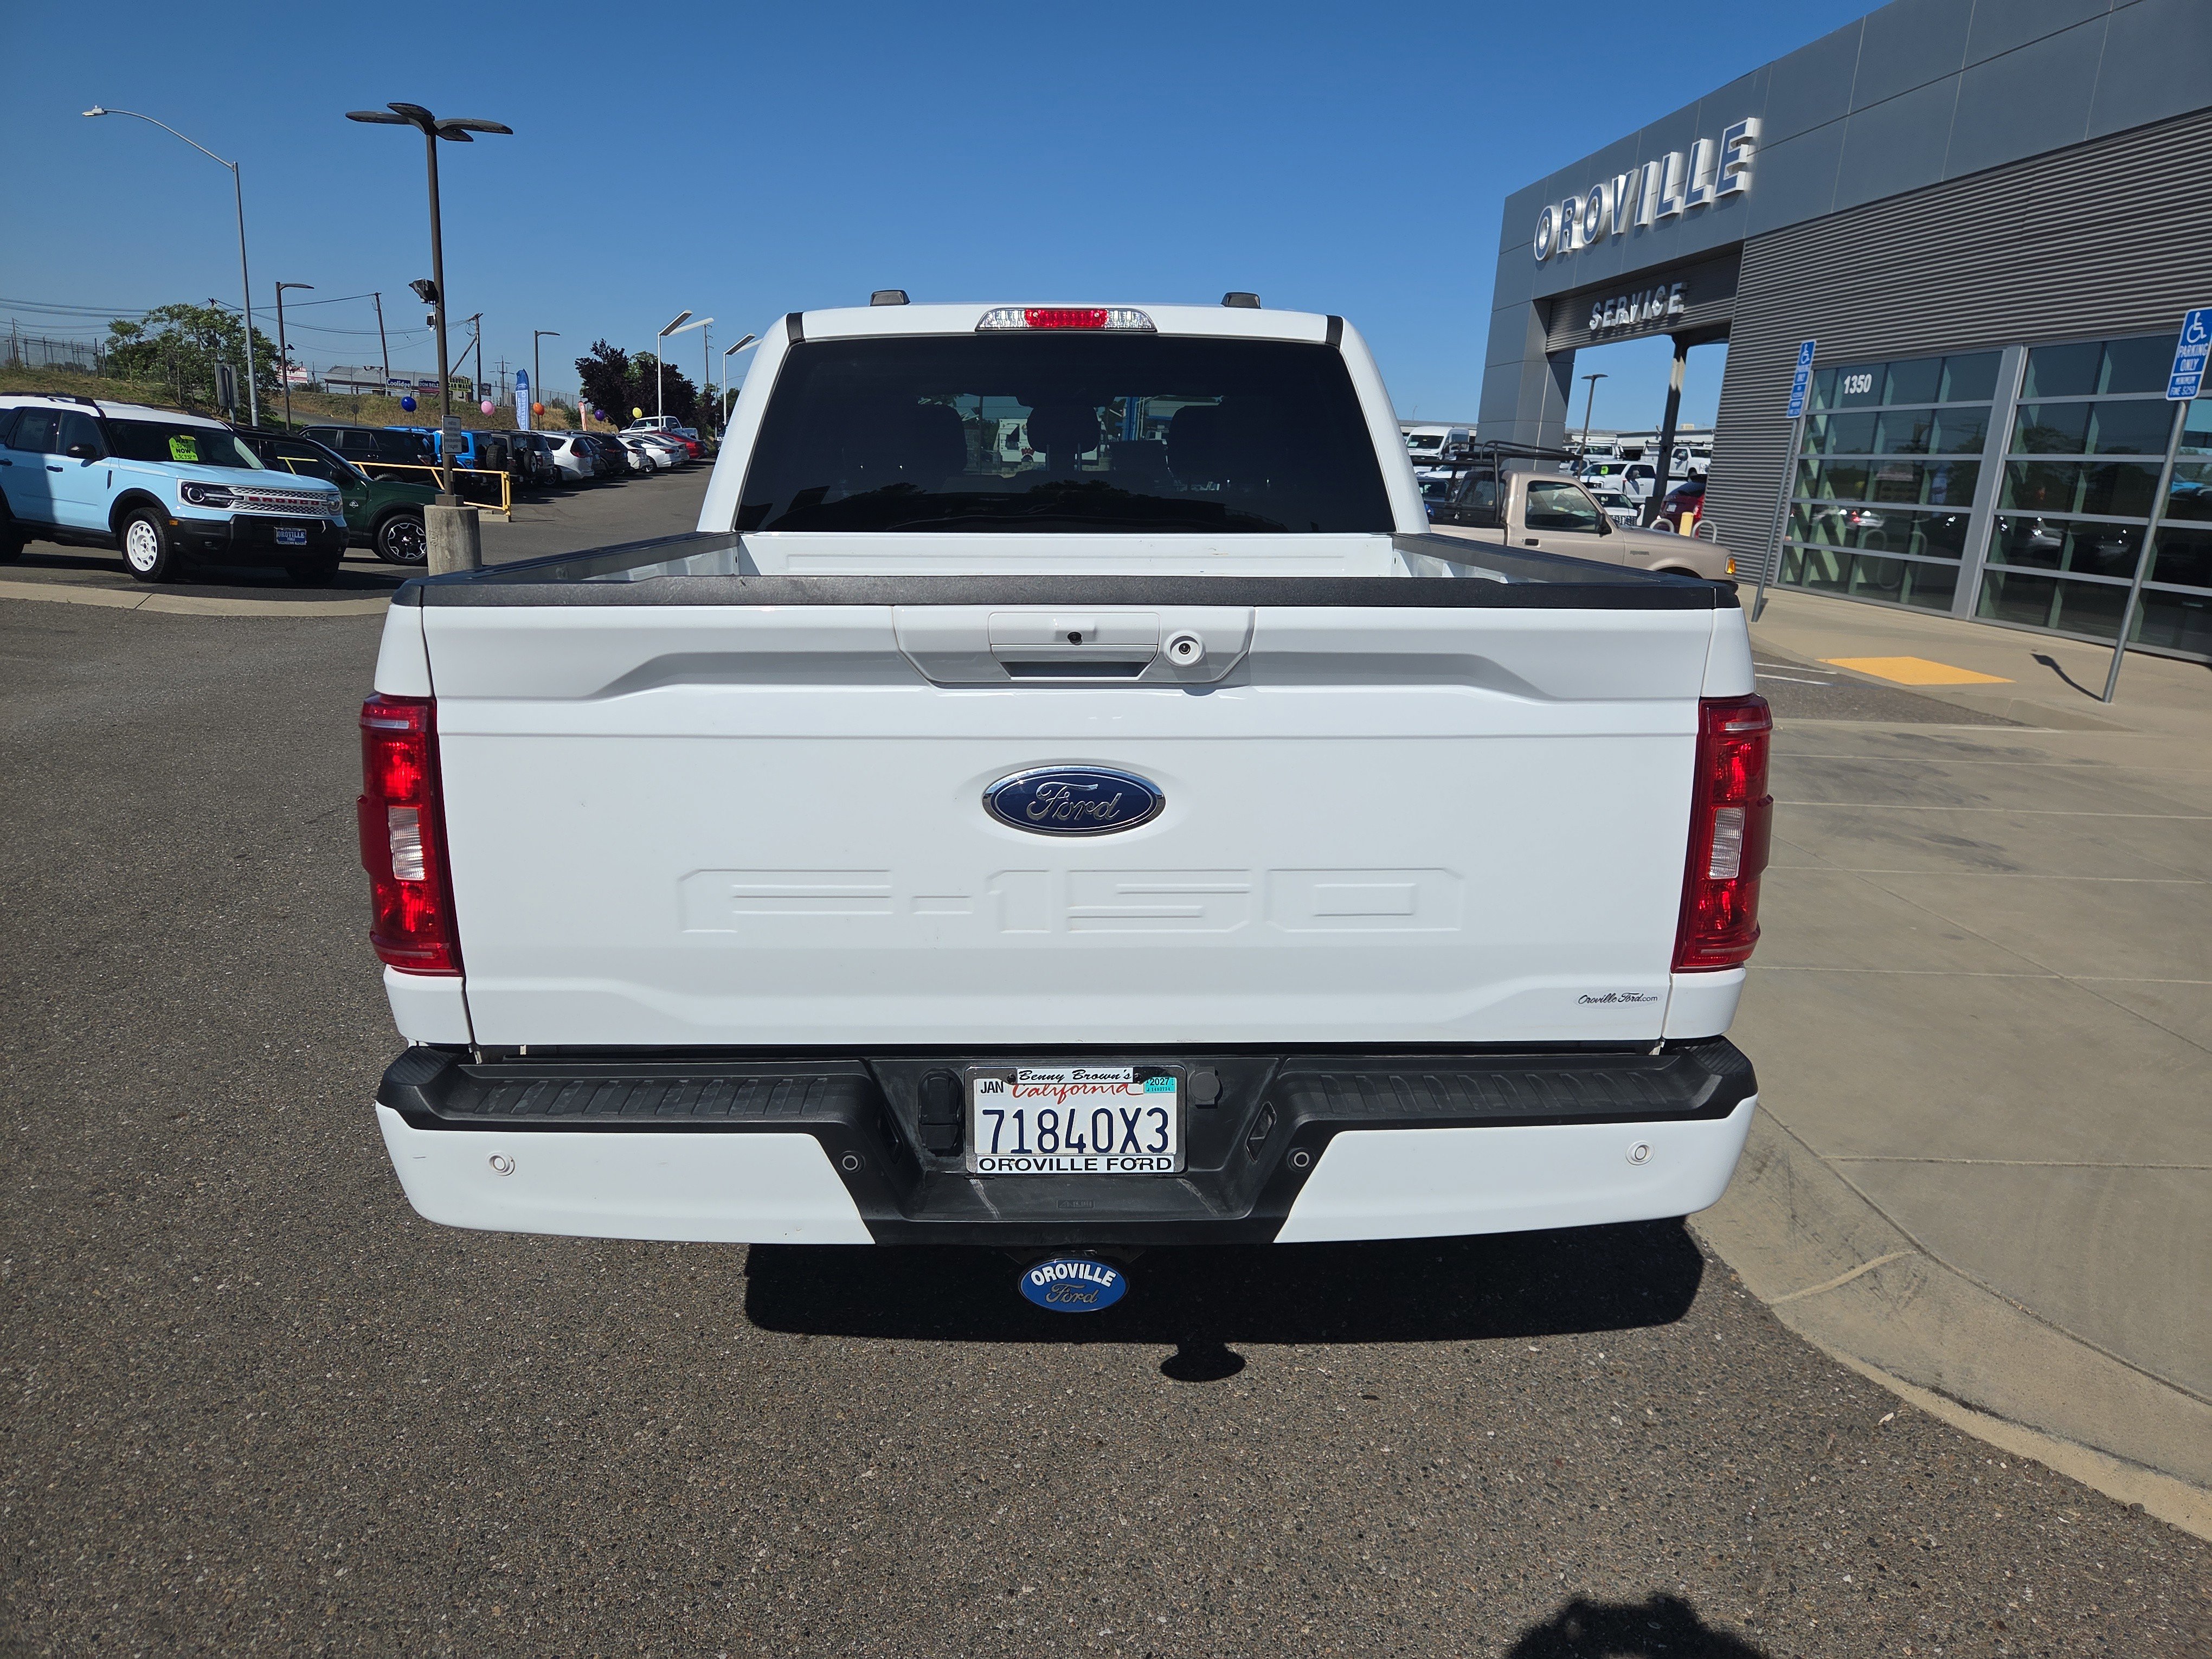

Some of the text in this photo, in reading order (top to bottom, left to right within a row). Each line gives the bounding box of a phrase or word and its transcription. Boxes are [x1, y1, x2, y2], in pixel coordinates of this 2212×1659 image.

[1534, 117, 1756, 261] OROVILLE
[1590, 282, 1687, 330] SERVICE
[2179, 358, 2200, 371] ONLY
[387, 378, 410, 389] Coolidge
[1844, 374, 1872, 394] 1350
[1026, 781, 1122, 821] Ford
[677, 868, 1465, 934] F-150
[1578, 993, 1617, 1004] Oroville
[1018, 1069, 1132, 1083] Benny Brown's
[1149, 1077, 1169, 1086] 2027
[981, 1081, 1004, 1094] JAN
[1012, 1084, 1144, 1104] California
[982, 1107, 1169, 1154] 71840X3
[979, 1158, 1172, 1171] OROVILLE FORD
[1031, 1263, 1116, 1287] OROVILLE
[1045, 1283, 1099, 1304] Ford
